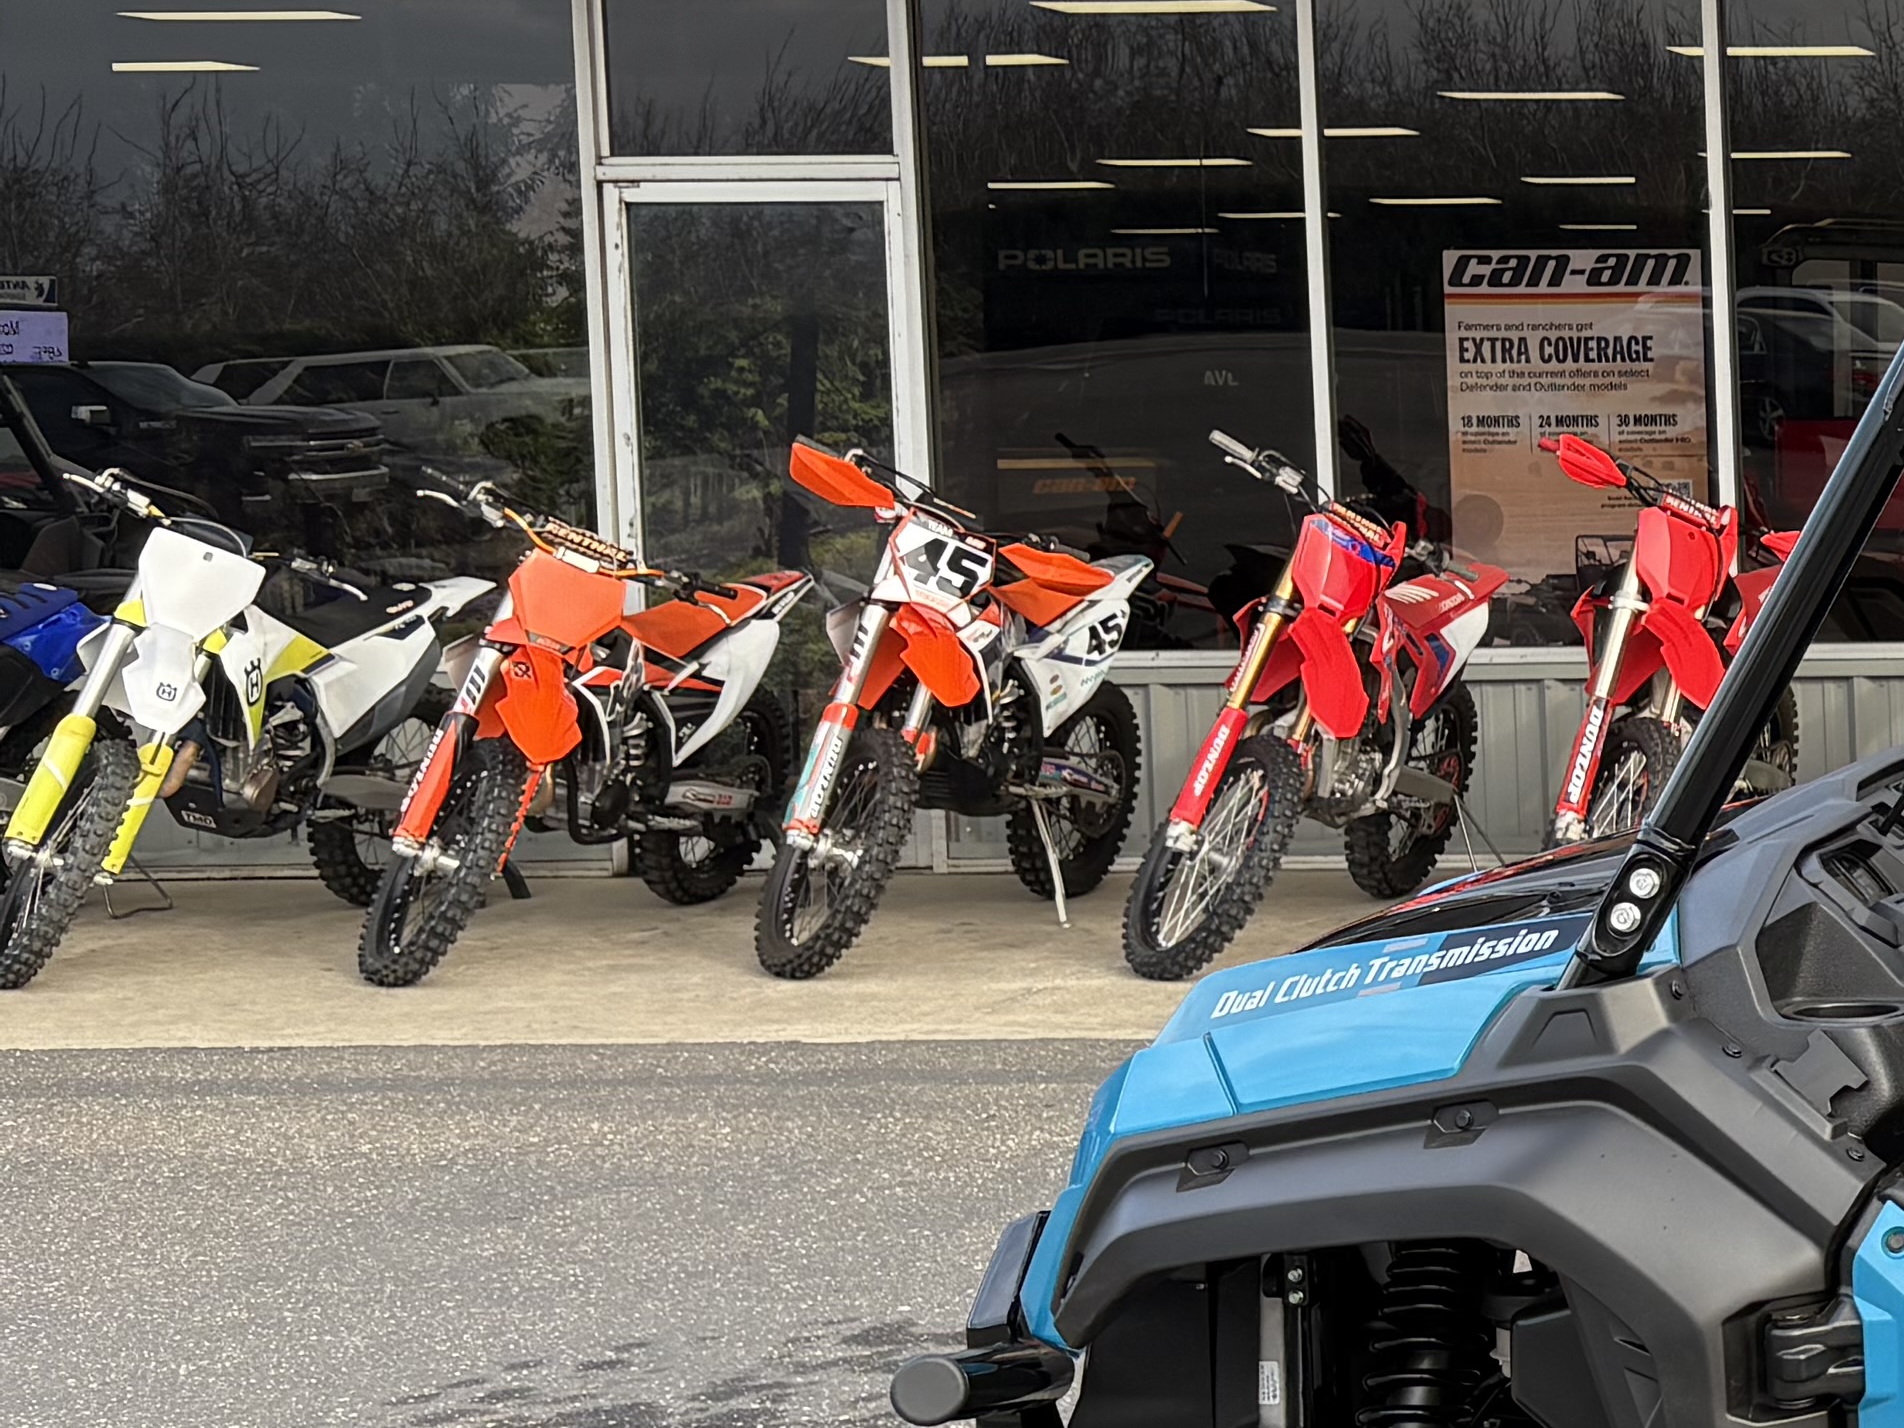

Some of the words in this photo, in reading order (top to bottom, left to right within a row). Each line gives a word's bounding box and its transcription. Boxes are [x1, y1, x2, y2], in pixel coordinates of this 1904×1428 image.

[998, 247, 1171, 270] POLARIS
[1447, 253, 1690, 288] can-am
[1458, 336, 1531, 364] EXTRA
[1538, 335, 1655, 364] COVERAGE
[1461, 416, 1473, 428] 18
[1476, 415, 1521, 429] MONTHS
[1538, 415, 1552, 428] 24
[1555, 414, 1600, 428] MONTHS
[1616, 414, 1630, 428] 30
[1633, 413, 1678, 428] MONTHS
[545, 523, 633, 563] RENTHAL
[904, 537, 989, 600] 45
[1087, 610, 1124, 657] 45
[1194, 724, 1231, 797] DUNLOP
[1567, 704, 1605, 804] DUNLOP
[809, 734, 844, 819] DUNLOP
[1210, 980, 1276, 1020] Dual
[1274, 963, 1362, 1004] Clutch
[1363, 928, 1560, 986] Transmission
